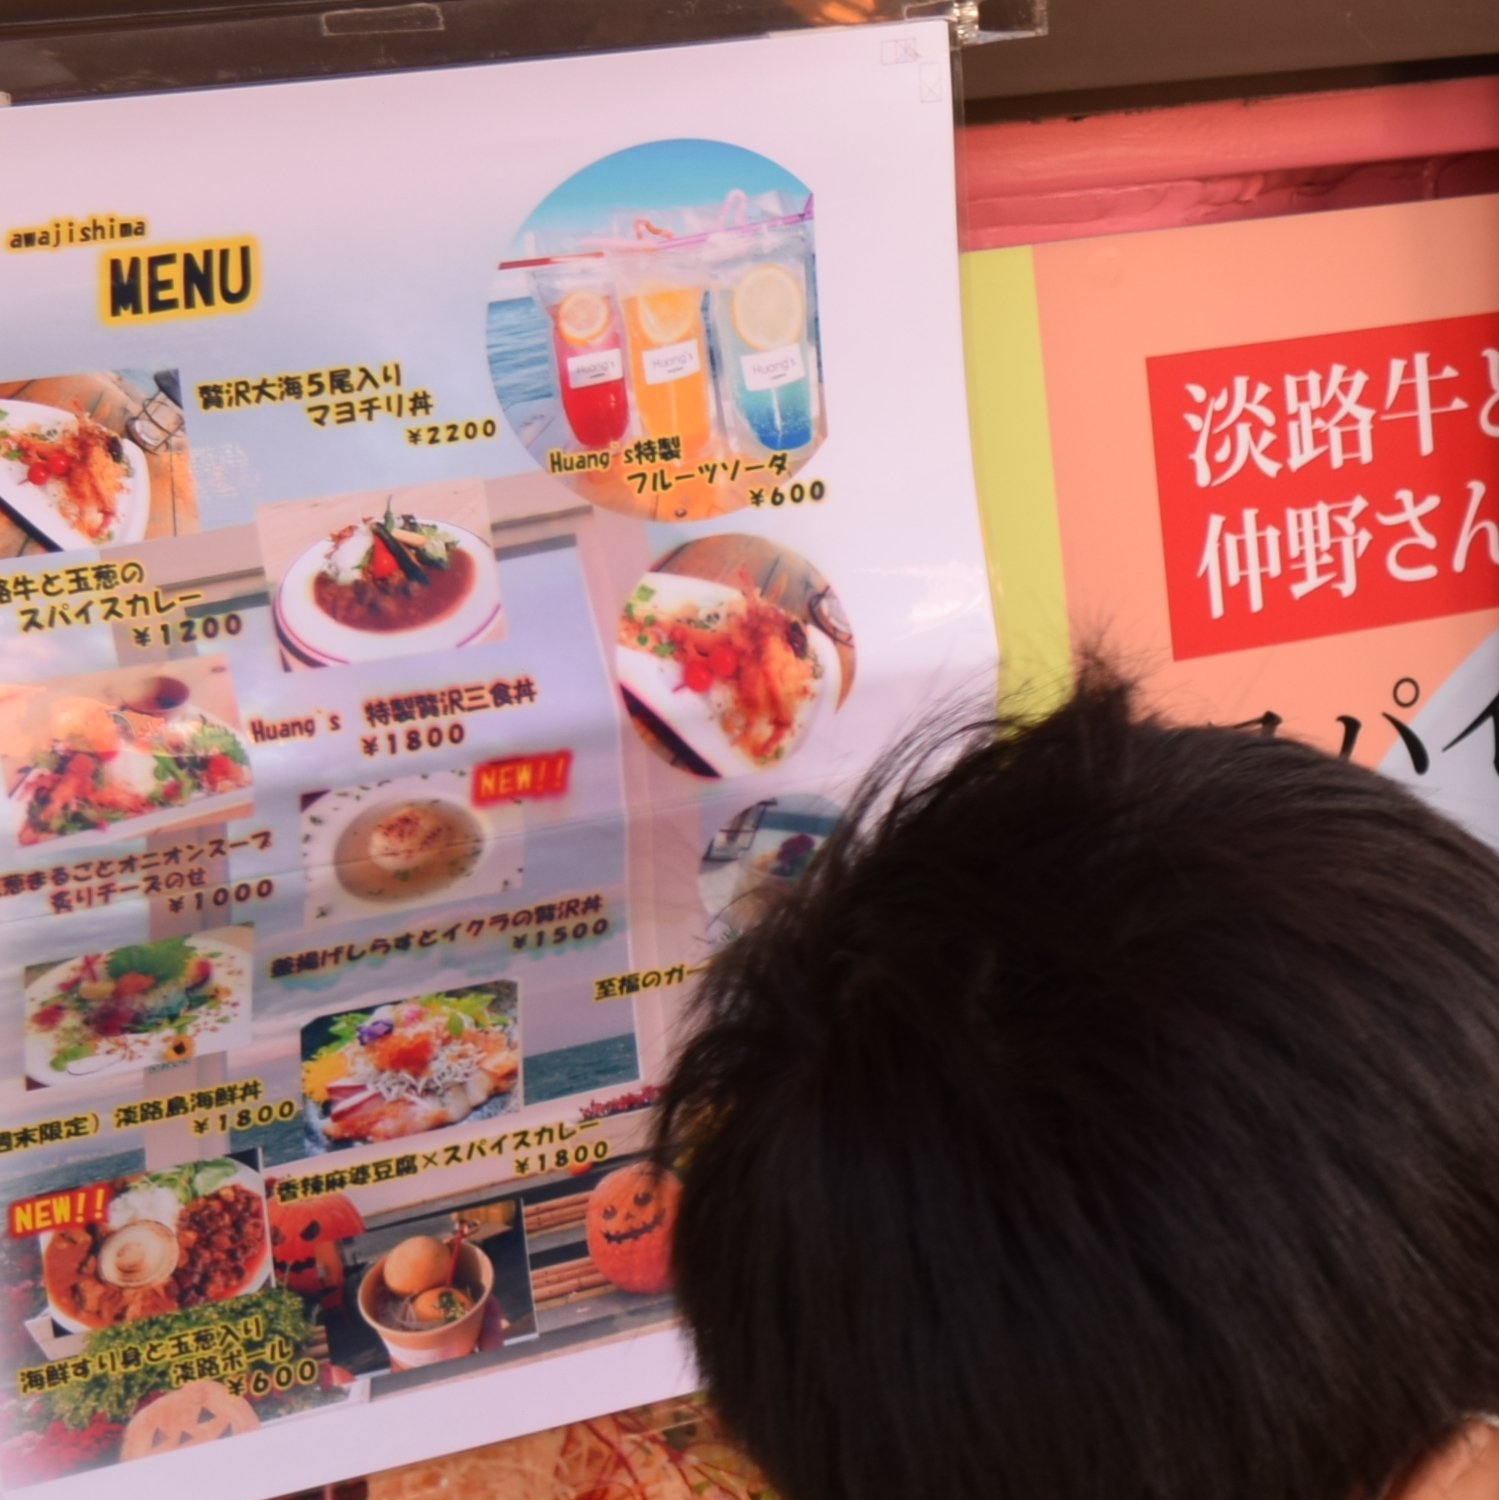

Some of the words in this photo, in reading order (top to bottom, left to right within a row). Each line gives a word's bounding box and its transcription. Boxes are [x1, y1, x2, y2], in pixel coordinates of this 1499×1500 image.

[9, 218, 147, 249] awajishima
[109, 245, 252, 317] MENU
[306, 390, 434, 427] マヨチリ丼
[626, 452, 788, 494] フルーツソーダ
[19, 590, 203, 633] スパイスカレー
